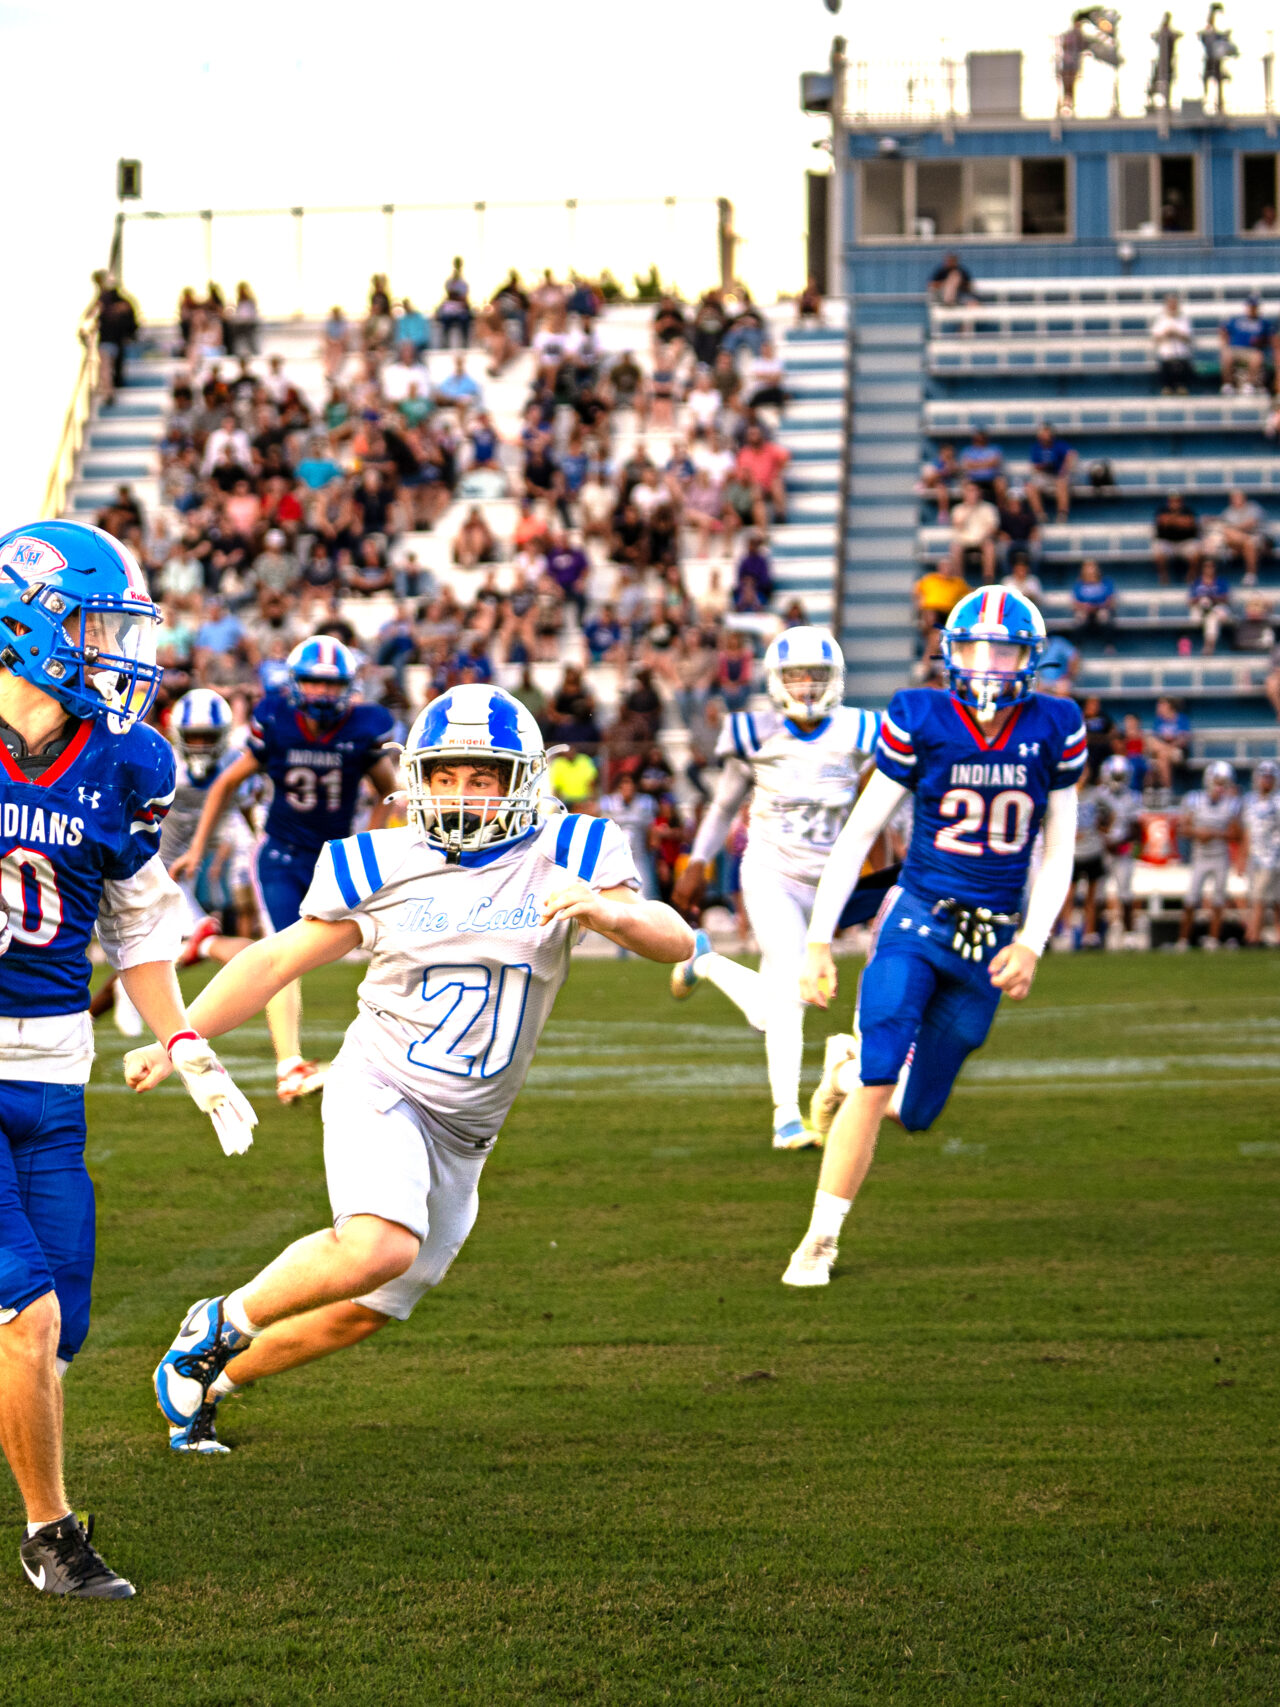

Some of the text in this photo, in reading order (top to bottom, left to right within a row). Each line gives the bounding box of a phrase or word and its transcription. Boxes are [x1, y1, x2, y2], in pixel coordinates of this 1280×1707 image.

[285, 767, 342, 811] 31
[950, 763, 1028, 787] INDIANS
[934, 787, 1035, 856] 20
[397, 893, 540, 932] The Lach
[407, 963, 532, 1079] 21
